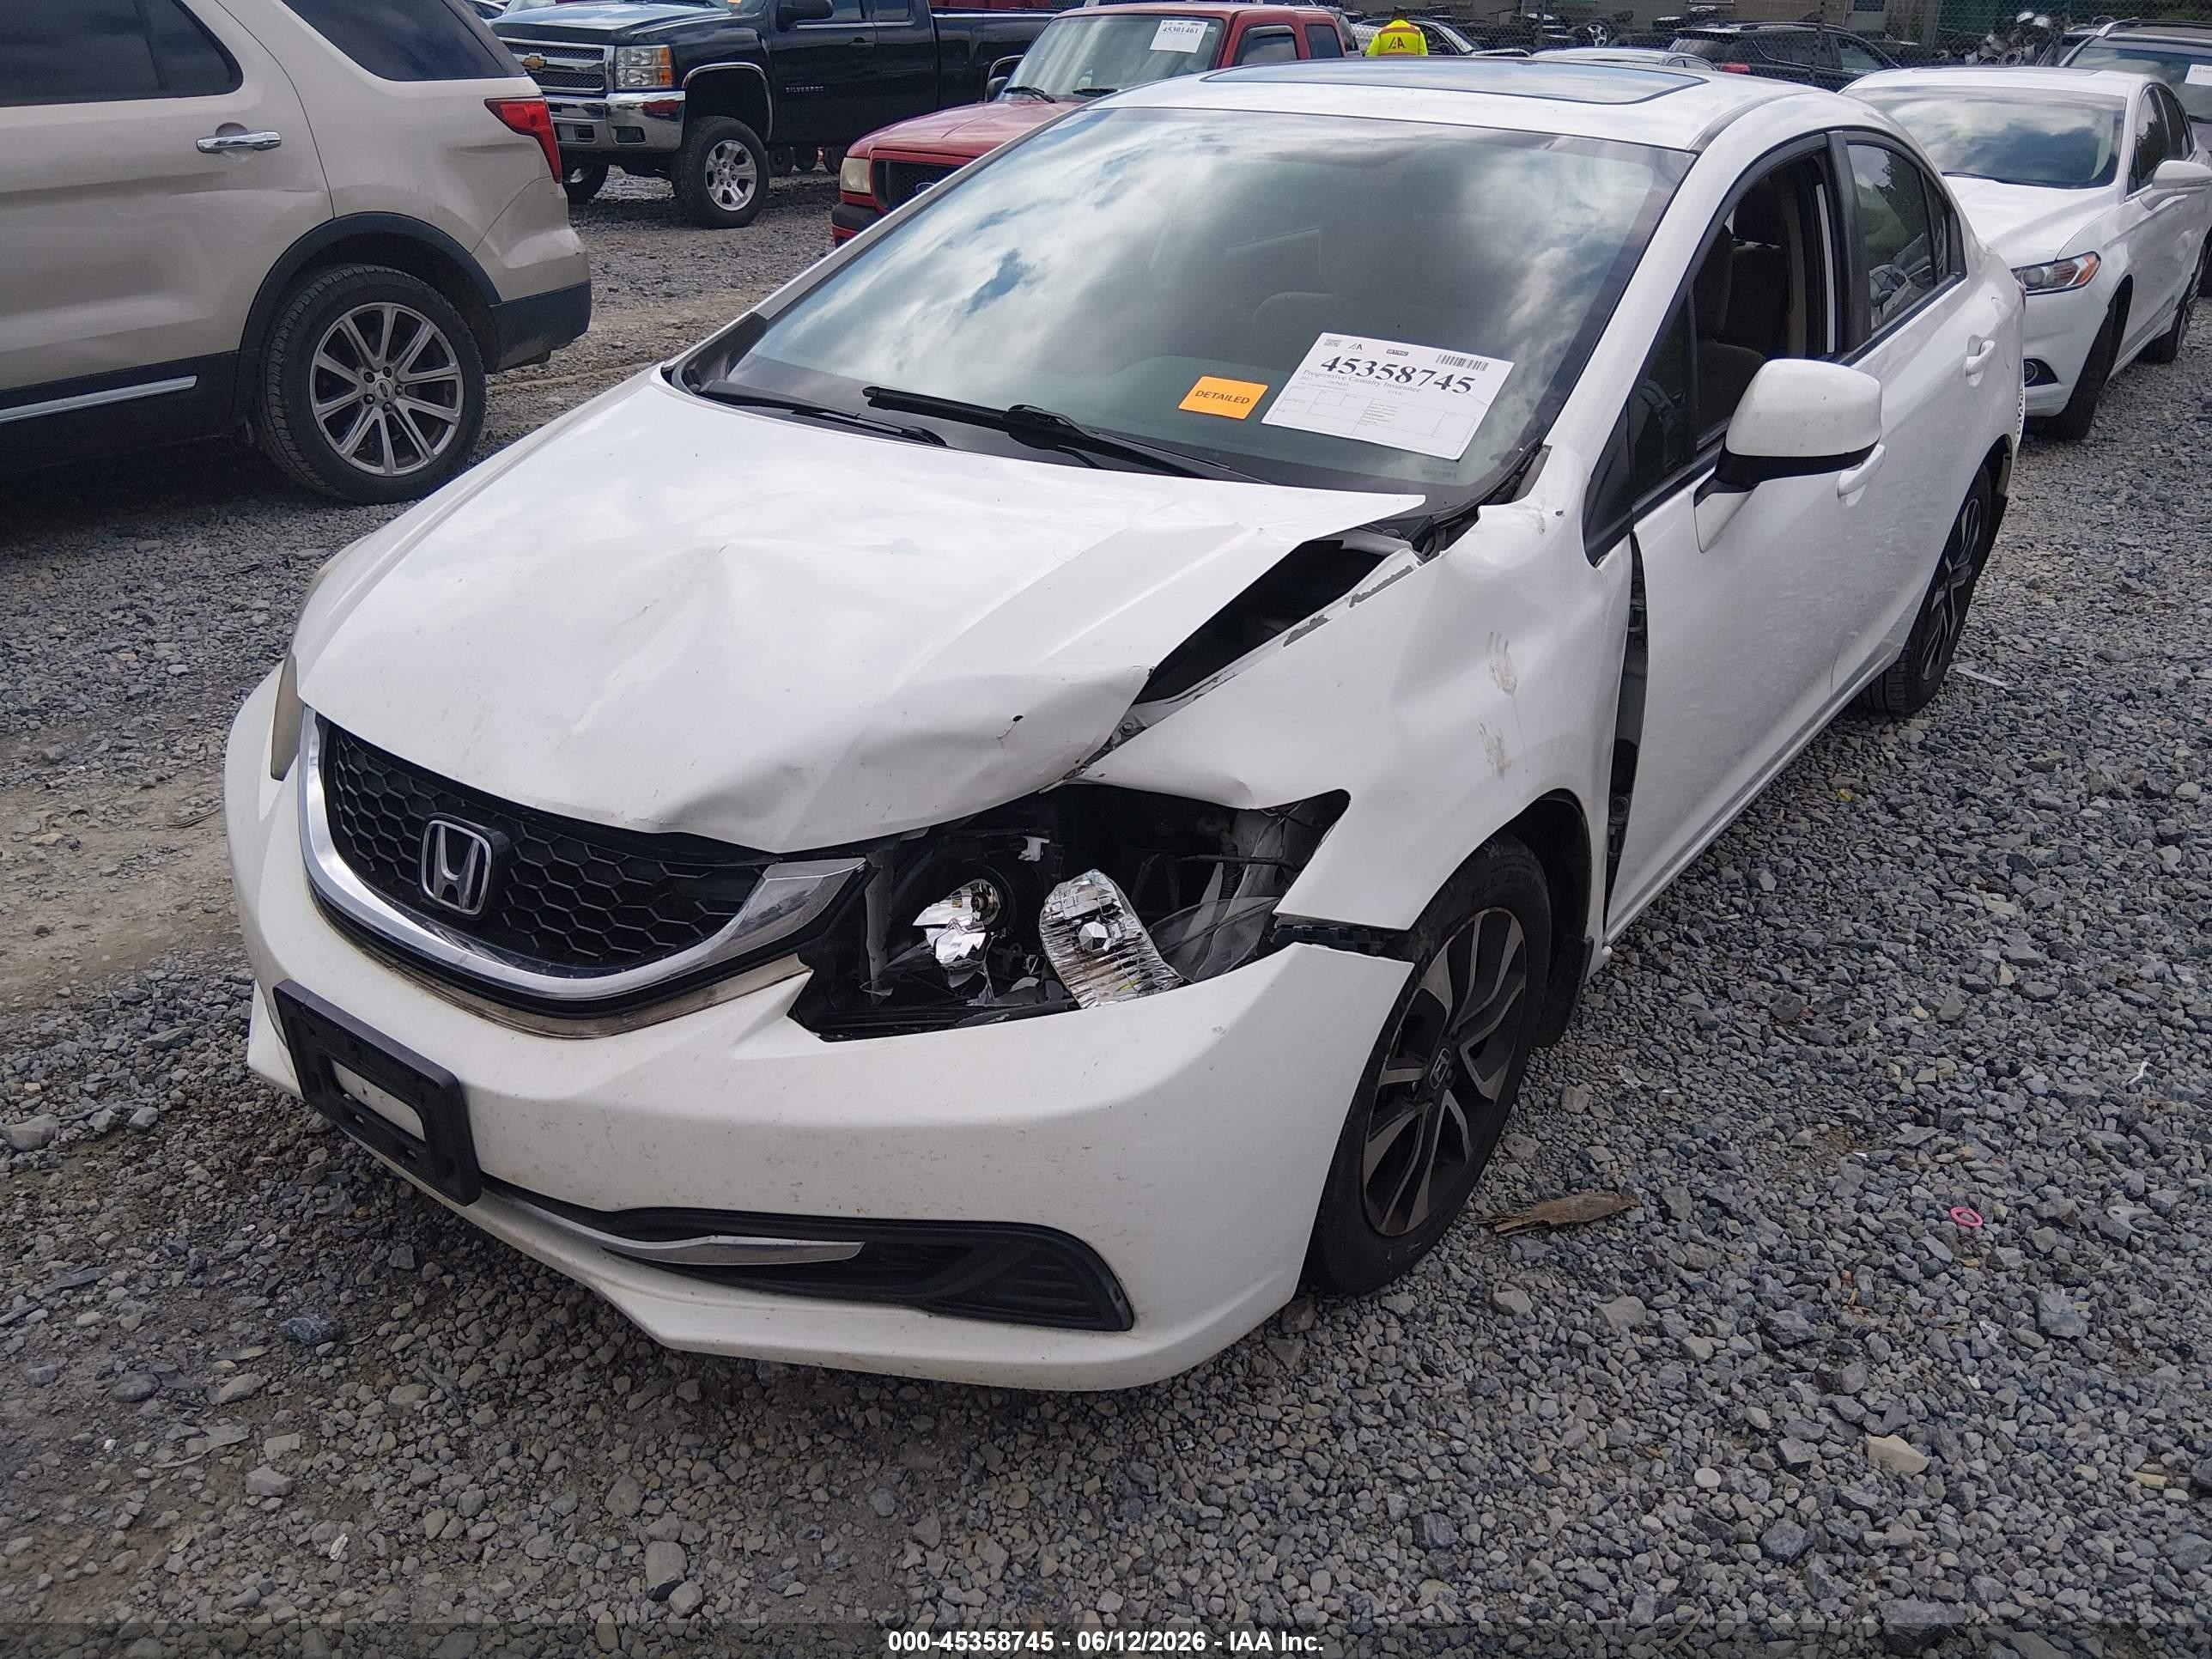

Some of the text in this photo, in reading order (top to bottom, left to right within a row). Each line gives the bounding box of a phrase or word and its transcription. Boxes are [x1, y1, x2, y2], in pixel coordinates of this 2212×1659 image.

[1304, 369, 1347, 380] Progressive
[1349, 377, 1381, 387] Casualty
[1383, 381, 1422, 393] Insurance
[1320, 356, 1476, 393] 45358745
[1194, 390, 1250, 404] DETAILED
